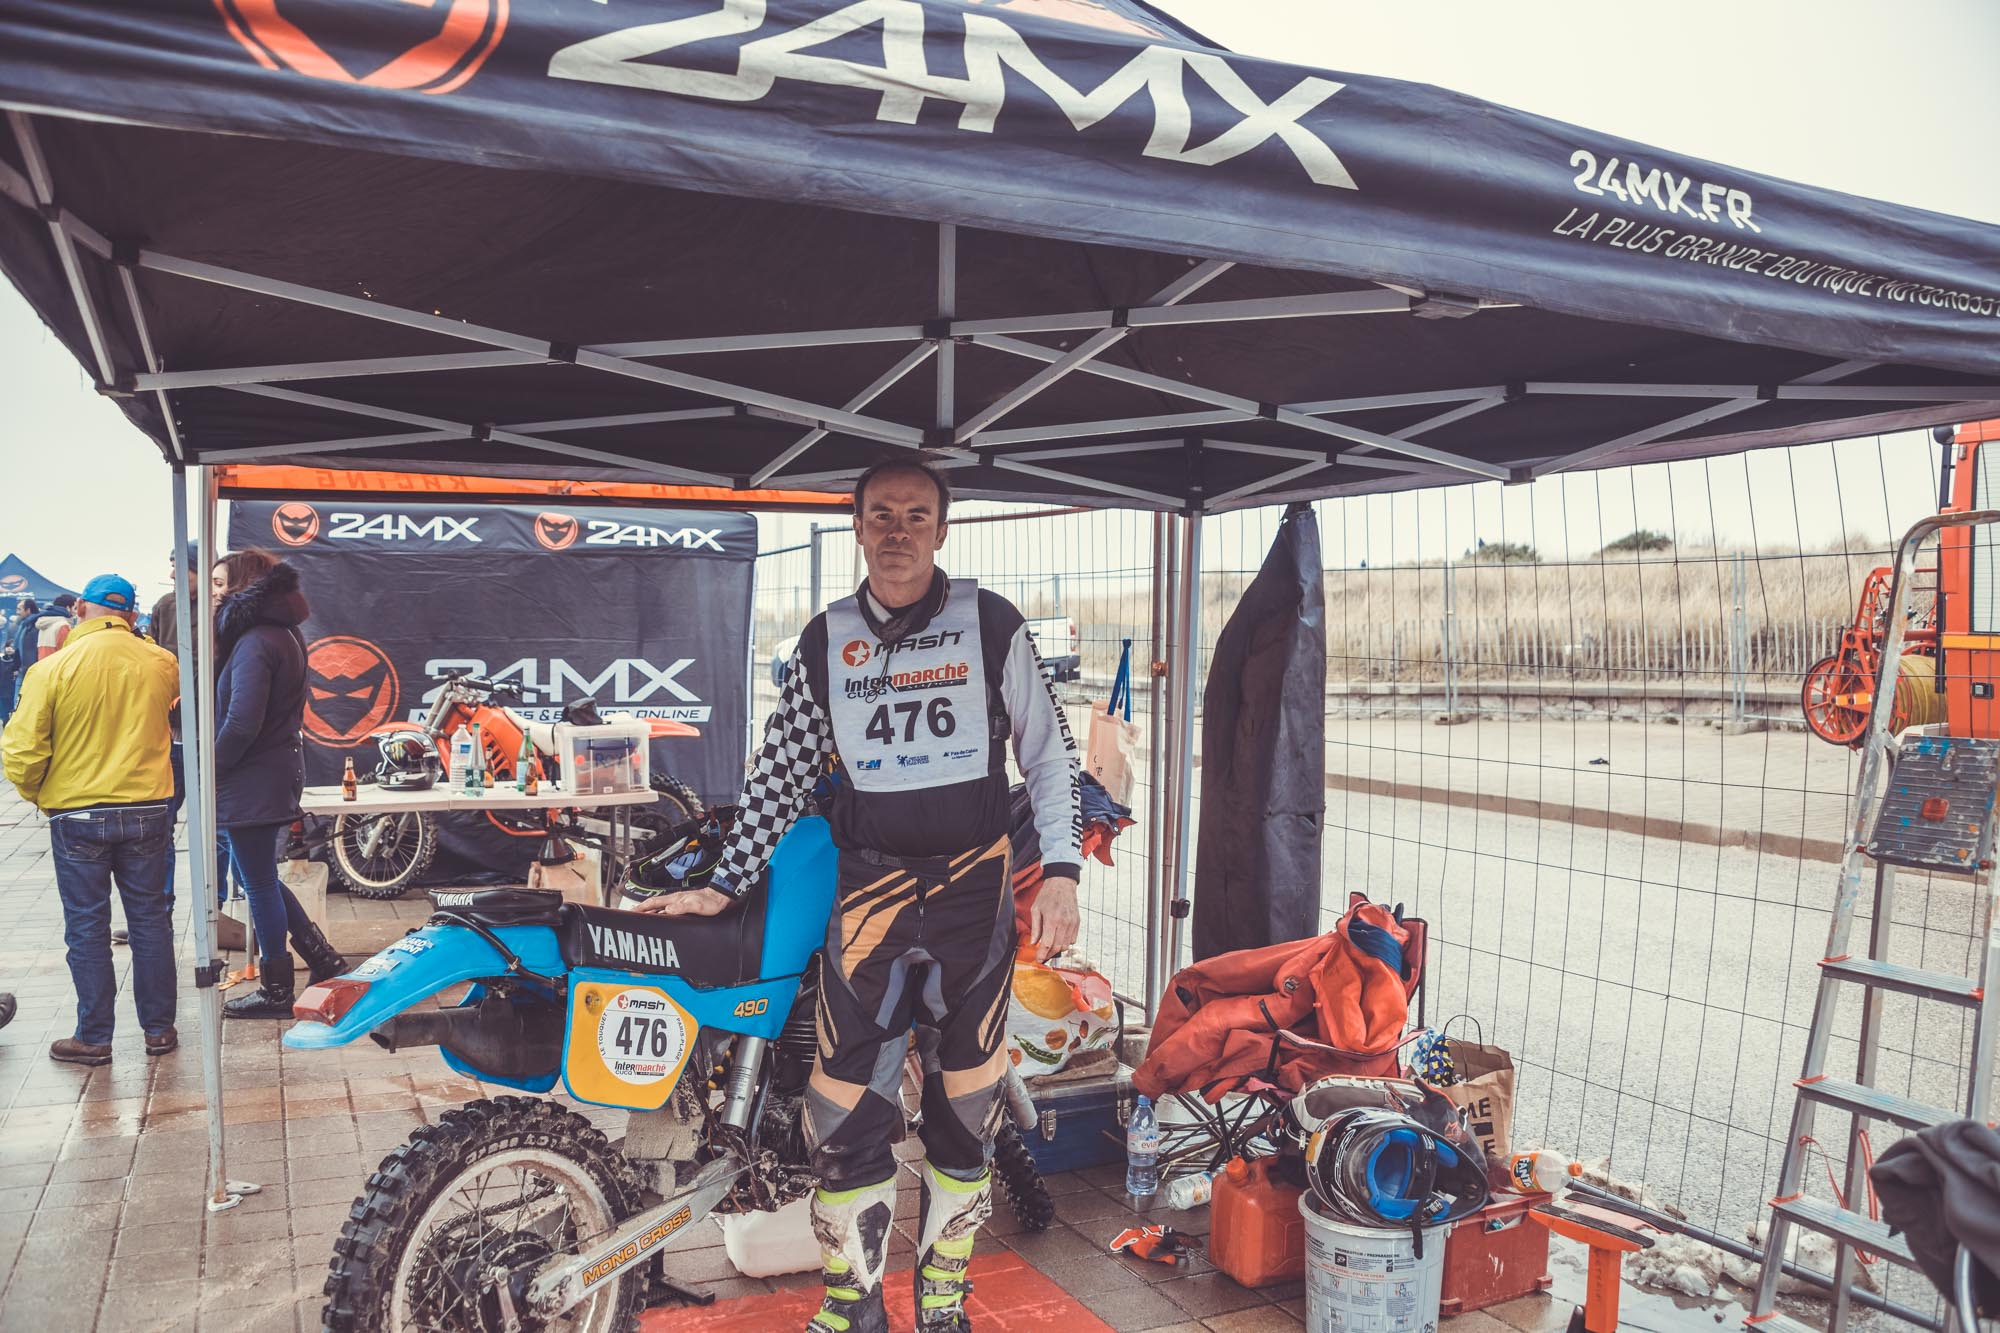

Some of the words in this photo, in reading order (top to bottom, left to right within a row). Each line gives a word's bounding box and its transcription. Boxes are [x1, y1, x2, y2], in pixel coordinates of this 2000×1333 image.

[547, 0, 1358, 191] 24MX
[1553, 208, 1599, 239] LA
[1592, 217, 1675, 253] PLUS
[1664, 234, 1778, 273] GRANDE
[1764, 256, 1888, 294] BOUTIQUE
[328, 513, 483, 542] 24MX
[585, 520, 725, 551] 24MX
[422, 658, 702, 703] 24MX
[636, 709, 700, 719] ONLINE
[865, 697, 956, 745] 476
[437, 893, 473, 907] YAMAHA
[587, 923, 681, 969] YAMAHA
[630, 999, 665, 1010] MASH
[734, 998, 768, 1018] 490
[598, 1012, 608, 1046] TOUQUET
[615, 1016, 668, 1058] 476
[614, 1061, 666, 1072] Intermarché
[582, 1242, 638, 1287] MONO
[639, 1205, 692, 1250] CROSS
